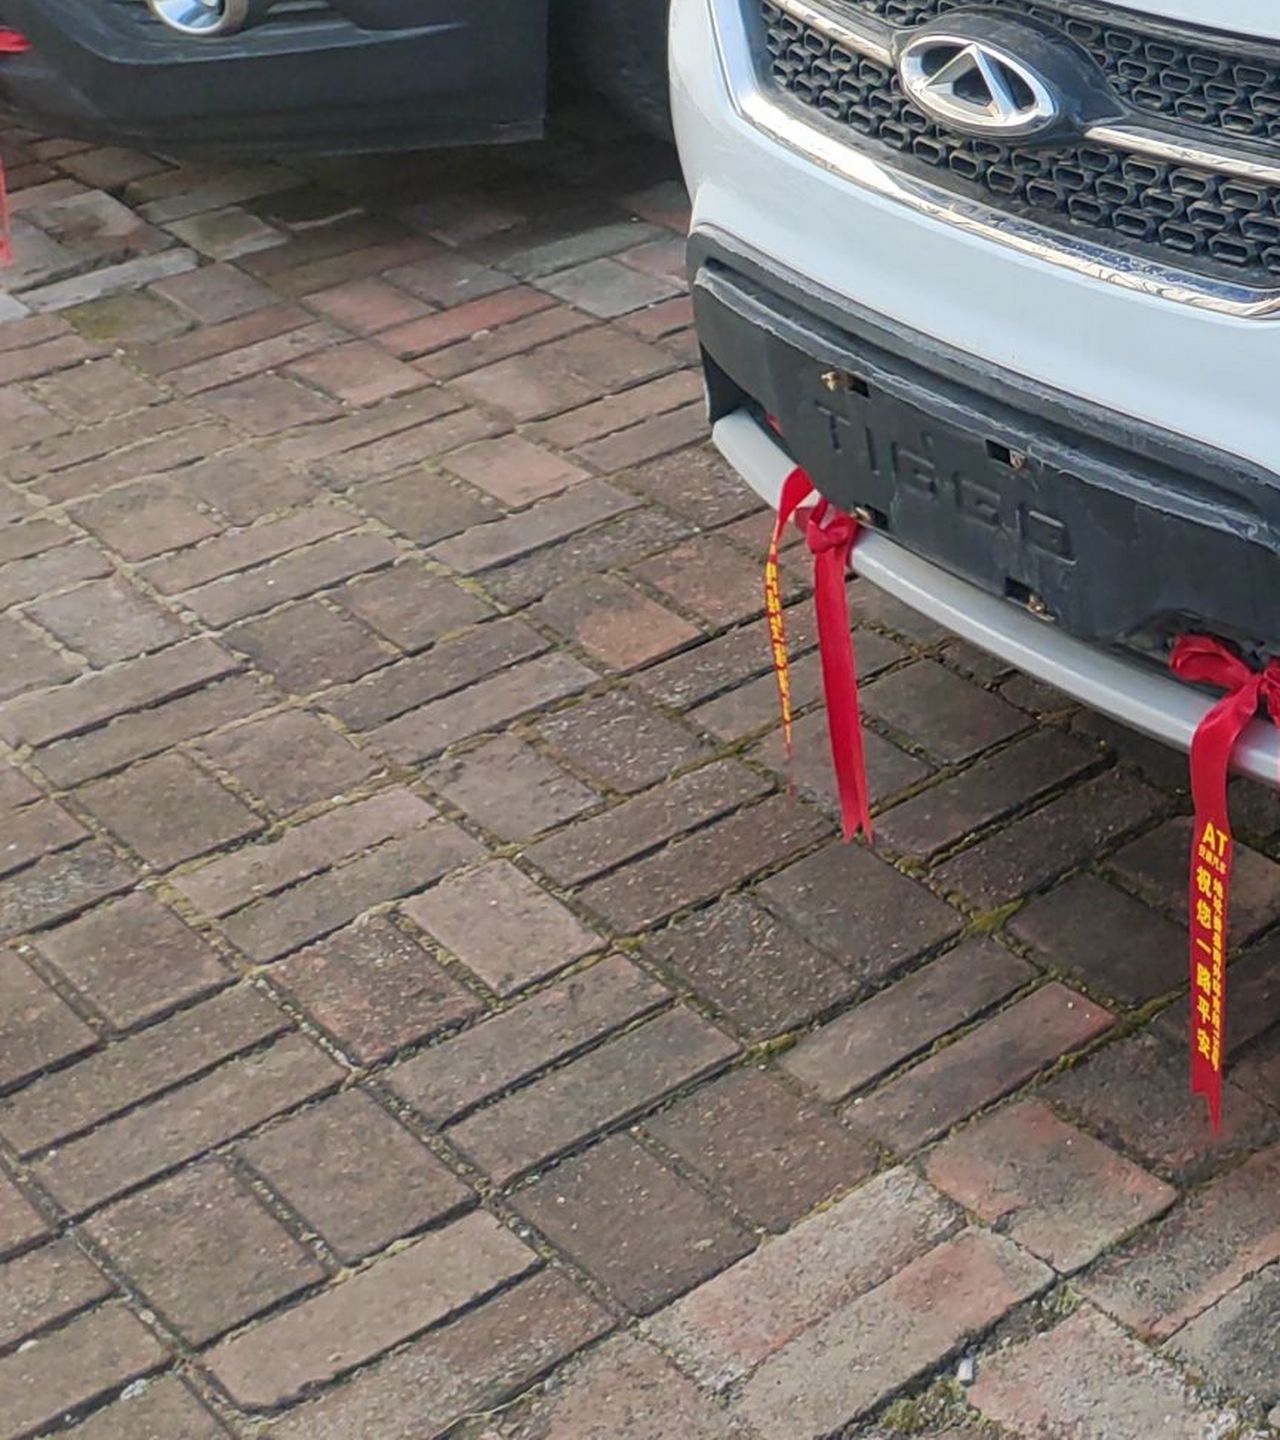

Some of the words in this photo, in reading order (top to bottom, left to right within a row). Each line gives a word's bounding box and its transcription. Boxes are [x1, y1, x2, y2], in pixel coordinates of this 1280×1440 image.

[1202, 821, 1228, 858] AT
[1196, 864, 1213, 1060] 祝您一路平安
